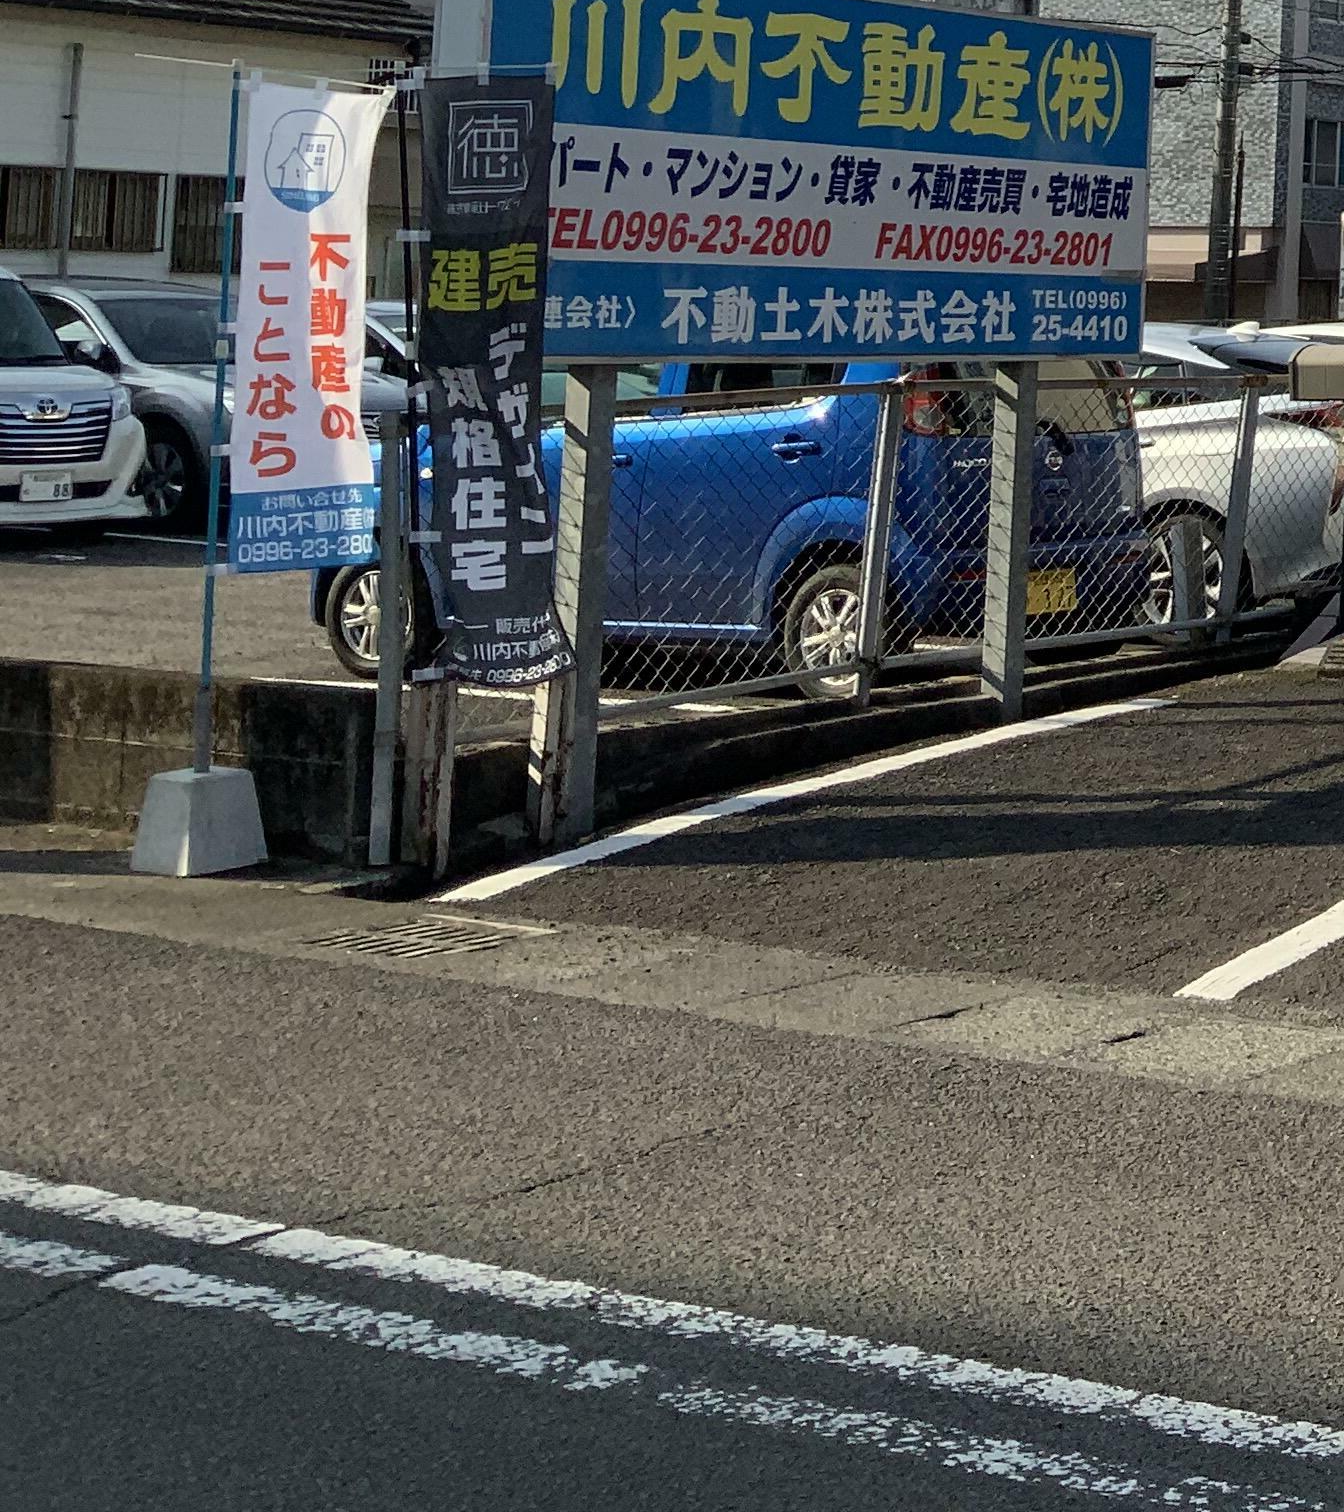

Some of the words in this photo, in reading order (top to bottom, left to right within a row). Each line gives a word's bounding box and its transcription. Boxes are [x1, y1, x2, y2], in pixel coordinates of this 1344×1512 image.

[547, 205, 832, 258] EL0996-23-2800
[874, 222, 1114, 268] FAX0996-23-2801
[427, 241, 539, 313] 建売
[1032, 288, 1128, 311] TEL(0996)
[309, 233, 356, 441] 不動産の
[660, 284, 1017, 346] 不動土木株式会社
[1031, 312, 1129, 344] 25-4410
[246, 261, 297, 478] ことなら
[261, 487, 363, 511] お問い合せ先
[436, 365, 507, 592] 規格住宅
[238, 533, 374, 564] 0996-23-280
